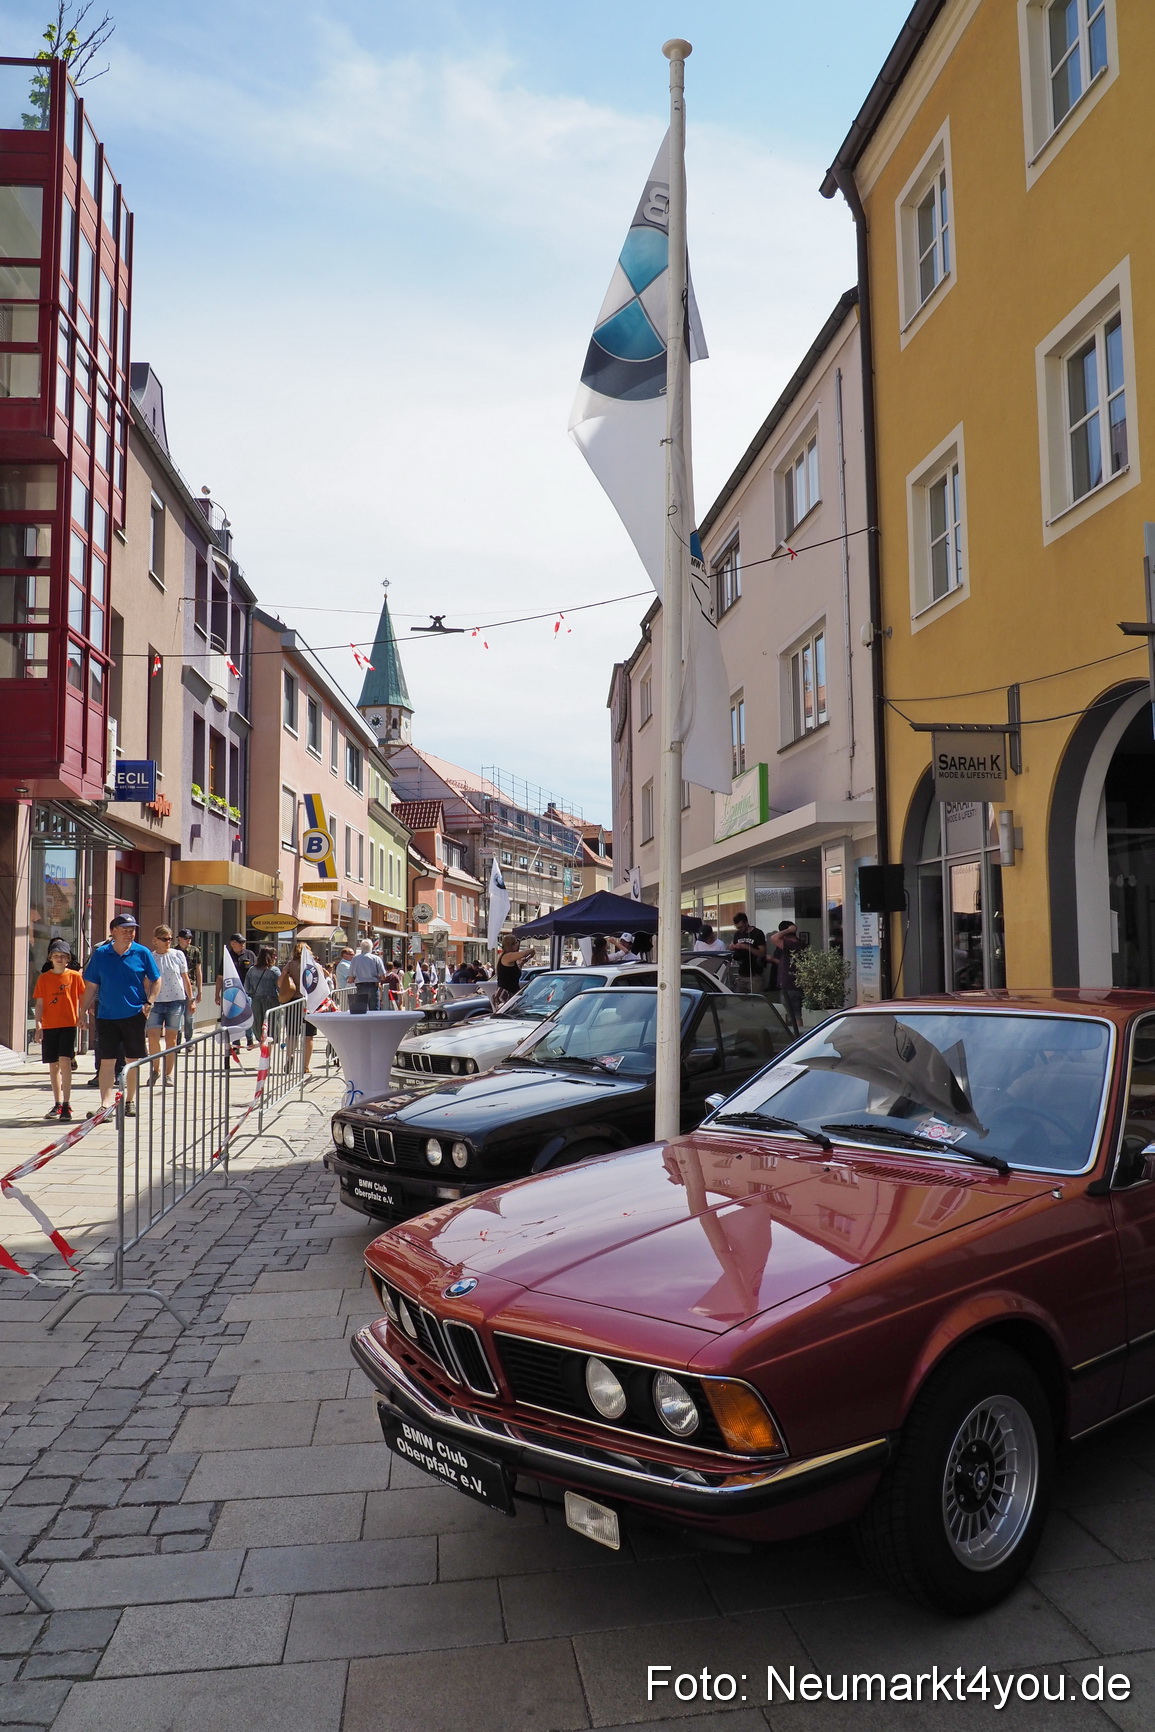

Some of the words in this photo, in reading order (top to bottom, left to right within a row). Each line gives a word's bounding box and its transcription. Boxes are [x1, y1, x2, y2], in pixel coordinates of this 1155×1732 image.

[938, 754, 986, 771] SARAH
[990, 754, 1000, 771] K
[117, 772, 149, 784] ECIL
[938, 771, 958, 779] MODE
[306, 836, 323, 853] B
[358, 1179, 373, 1189] BMW
[374, 1182, 388, 1193] Club
[354, 1187, 382, 1202] Oberpfalz
[383, 1196, 394, 1205] e.V.
[402, 1423, 433, 1451] BMW
[437, 1441, 468, 1469] Club
[396, 1437, 458, 1482] Oberpfalz
[460, 1474, 487, 1497] e.V.
